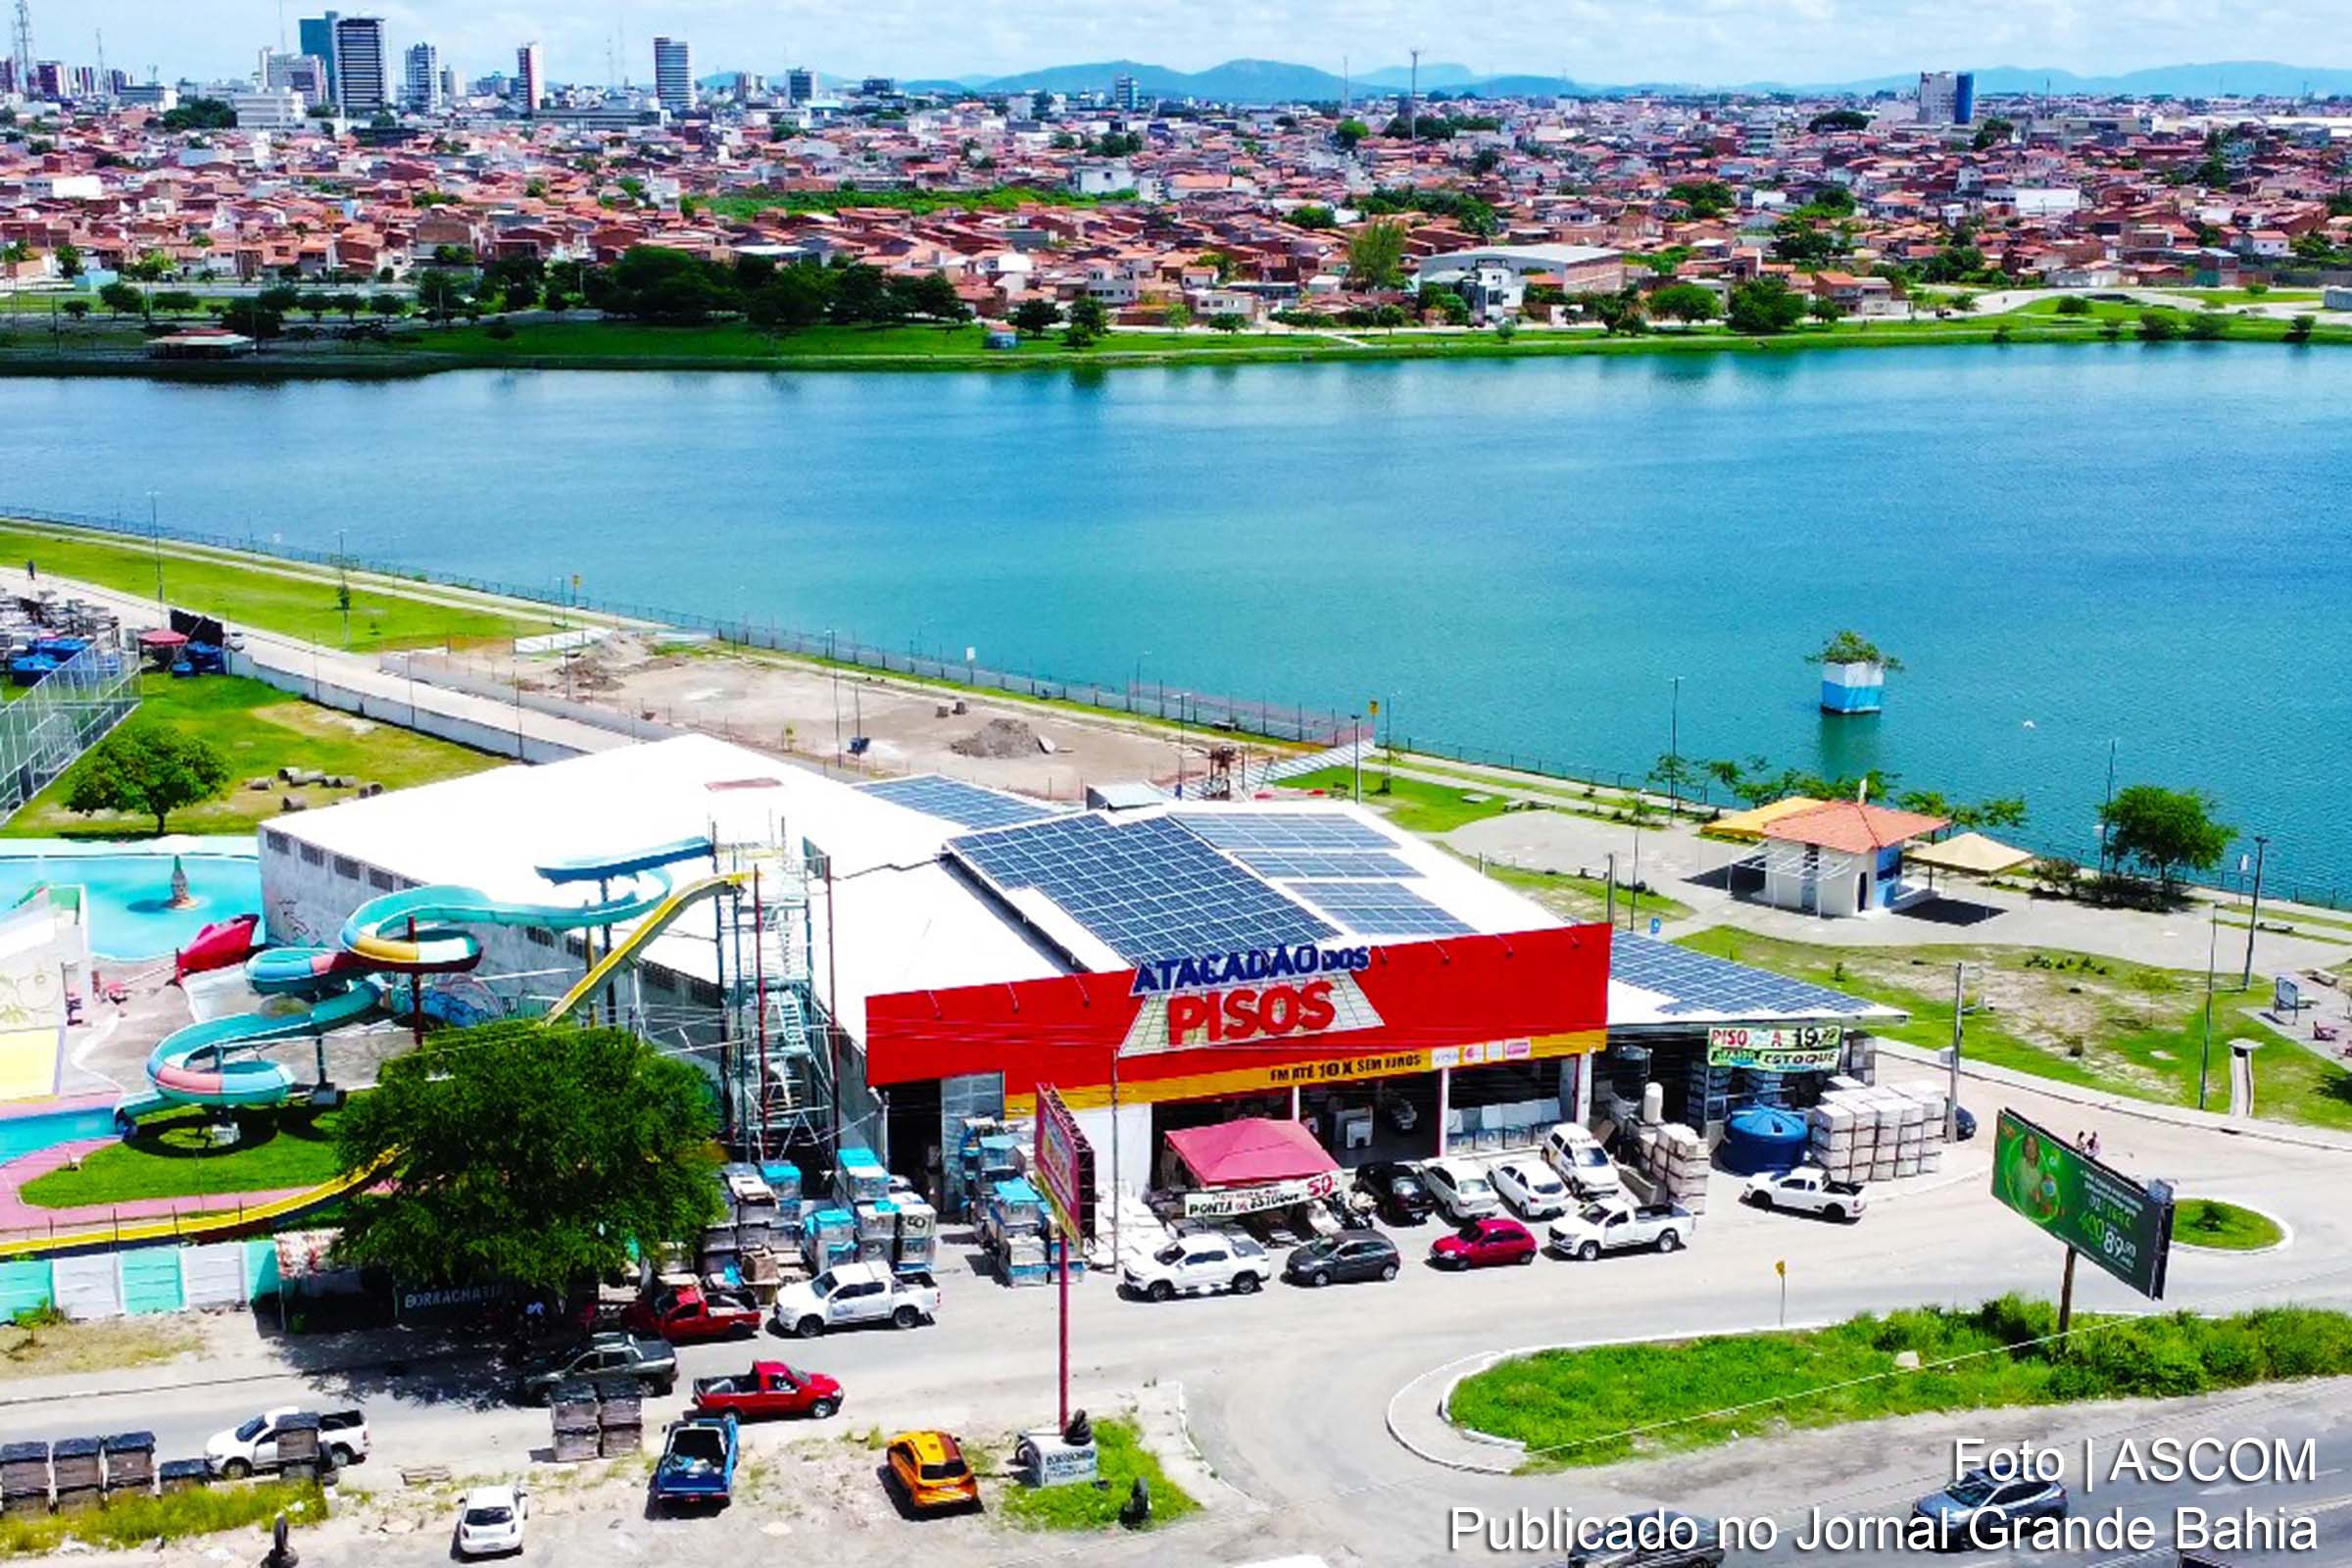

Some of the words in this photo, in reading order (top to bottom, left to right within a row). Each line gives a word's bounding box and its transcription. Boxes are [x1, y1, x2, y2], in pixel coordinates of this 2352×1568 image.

[1132, 944, 1317, 995] ATACADÃO
[1322, 946, 1371, 971] DOS
[1167, 980, 1337, 1046] PISOS
[1711, 1029, 1748, 1047] PISO
[1357, 1057, 1383, 1073] SEM
